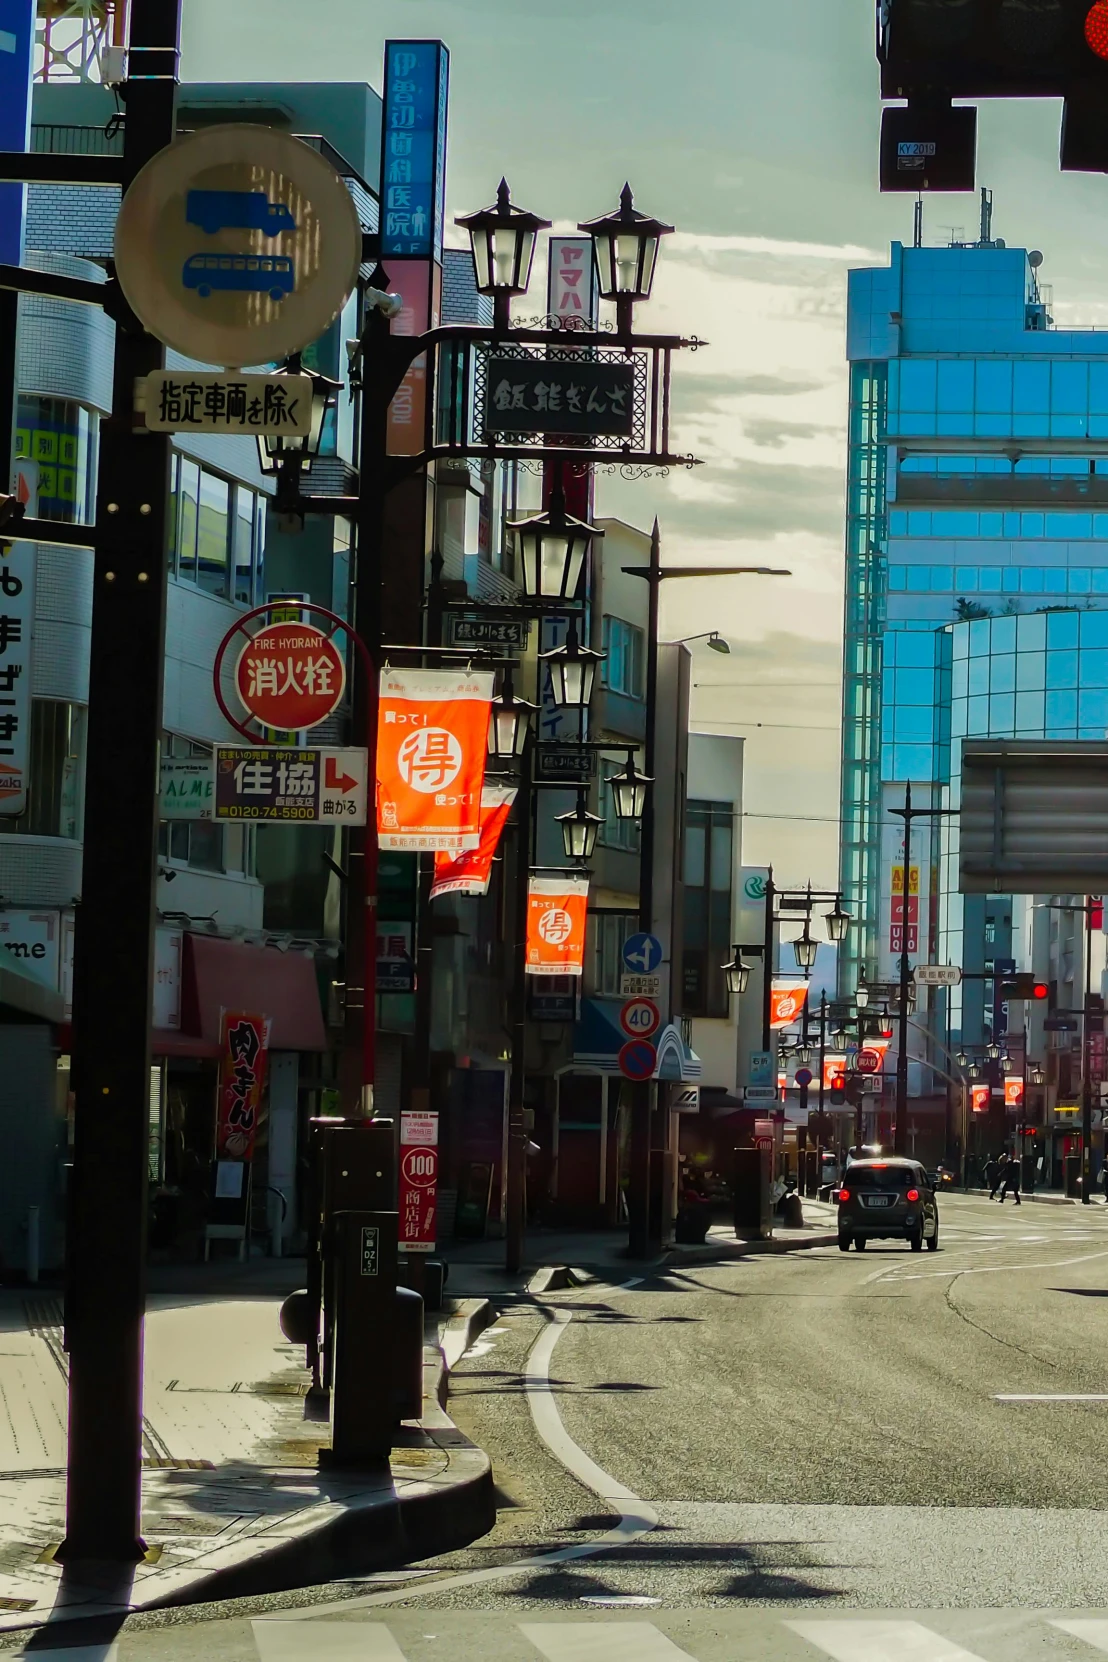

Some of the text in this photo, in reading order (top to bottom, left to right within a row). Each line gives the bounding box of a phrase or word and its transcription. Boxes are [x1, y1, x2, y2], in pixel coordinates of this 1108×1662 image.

[899, 143, 935, 155] KY 2019
[158, 380, 299, 426] 指定車両を除く
[492, 379, 631, 416] 飯能ぎんざ
[254, 637, 324, 650] FIRE HYDRANT
[247, 655, 335, 697] 消火栓
[402, 733, 458, 787] 得
[159, 778, 214, 798] ALME
[233, 761, 316, 796] 住協
[229, 806, 315, 819] 0120-74-5900
[323, 799, 357, 816] 曲がる
[541, 911, 569, 939] 得
[629, 1008, 651, 1027] 40
[228, 1021, 260, 1130] 肉まん
[409, 1155, 435, 1176] 100
[427, 1187, 435, 1196] 円
[404, 1189, 421, 1238] 商店街
[364, 1250, 376, 1259] DZ
